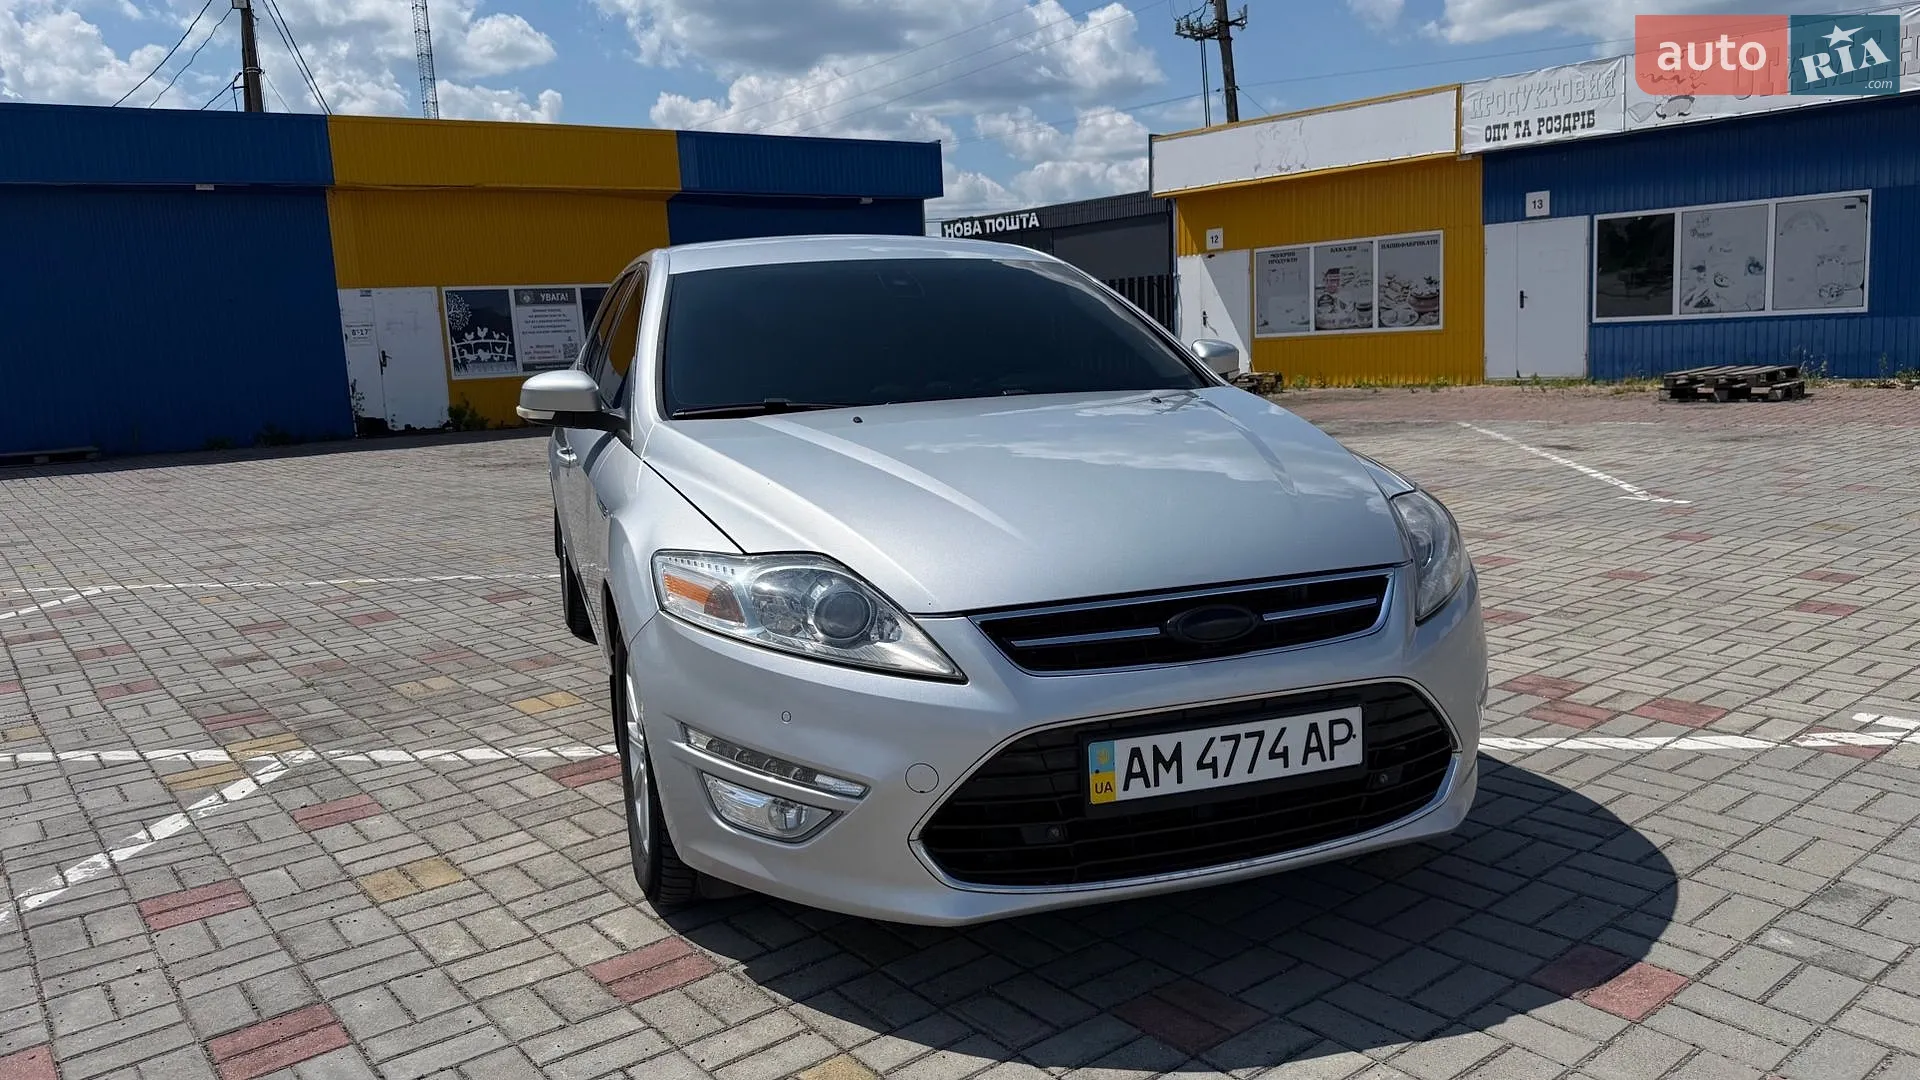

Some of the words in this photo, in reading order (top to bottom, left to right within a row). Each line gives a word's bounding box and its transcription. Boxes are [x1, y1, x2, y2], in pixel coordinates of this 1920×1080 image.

[1485, 123, 1509, 142] ОПТ
[1514, 120, 1532, 138] ТА
[1537, 110, 1595, 135] РОЗДРІБ
[1532, 199, 1543, 209] 13
[944, 220, 982, 238] НОВА
[984, 212, 1040, 233] ПОШТА
[1210, 235, 1219, 244] 12
[540, 292, 568, 301] УВАГА!
[1123, 742, 1183, 791] AM
[1196, 727, 1289, 779] 4774
[1301, 718, 1353, 765] AP
[1094, 781, 1113, 794] UA
